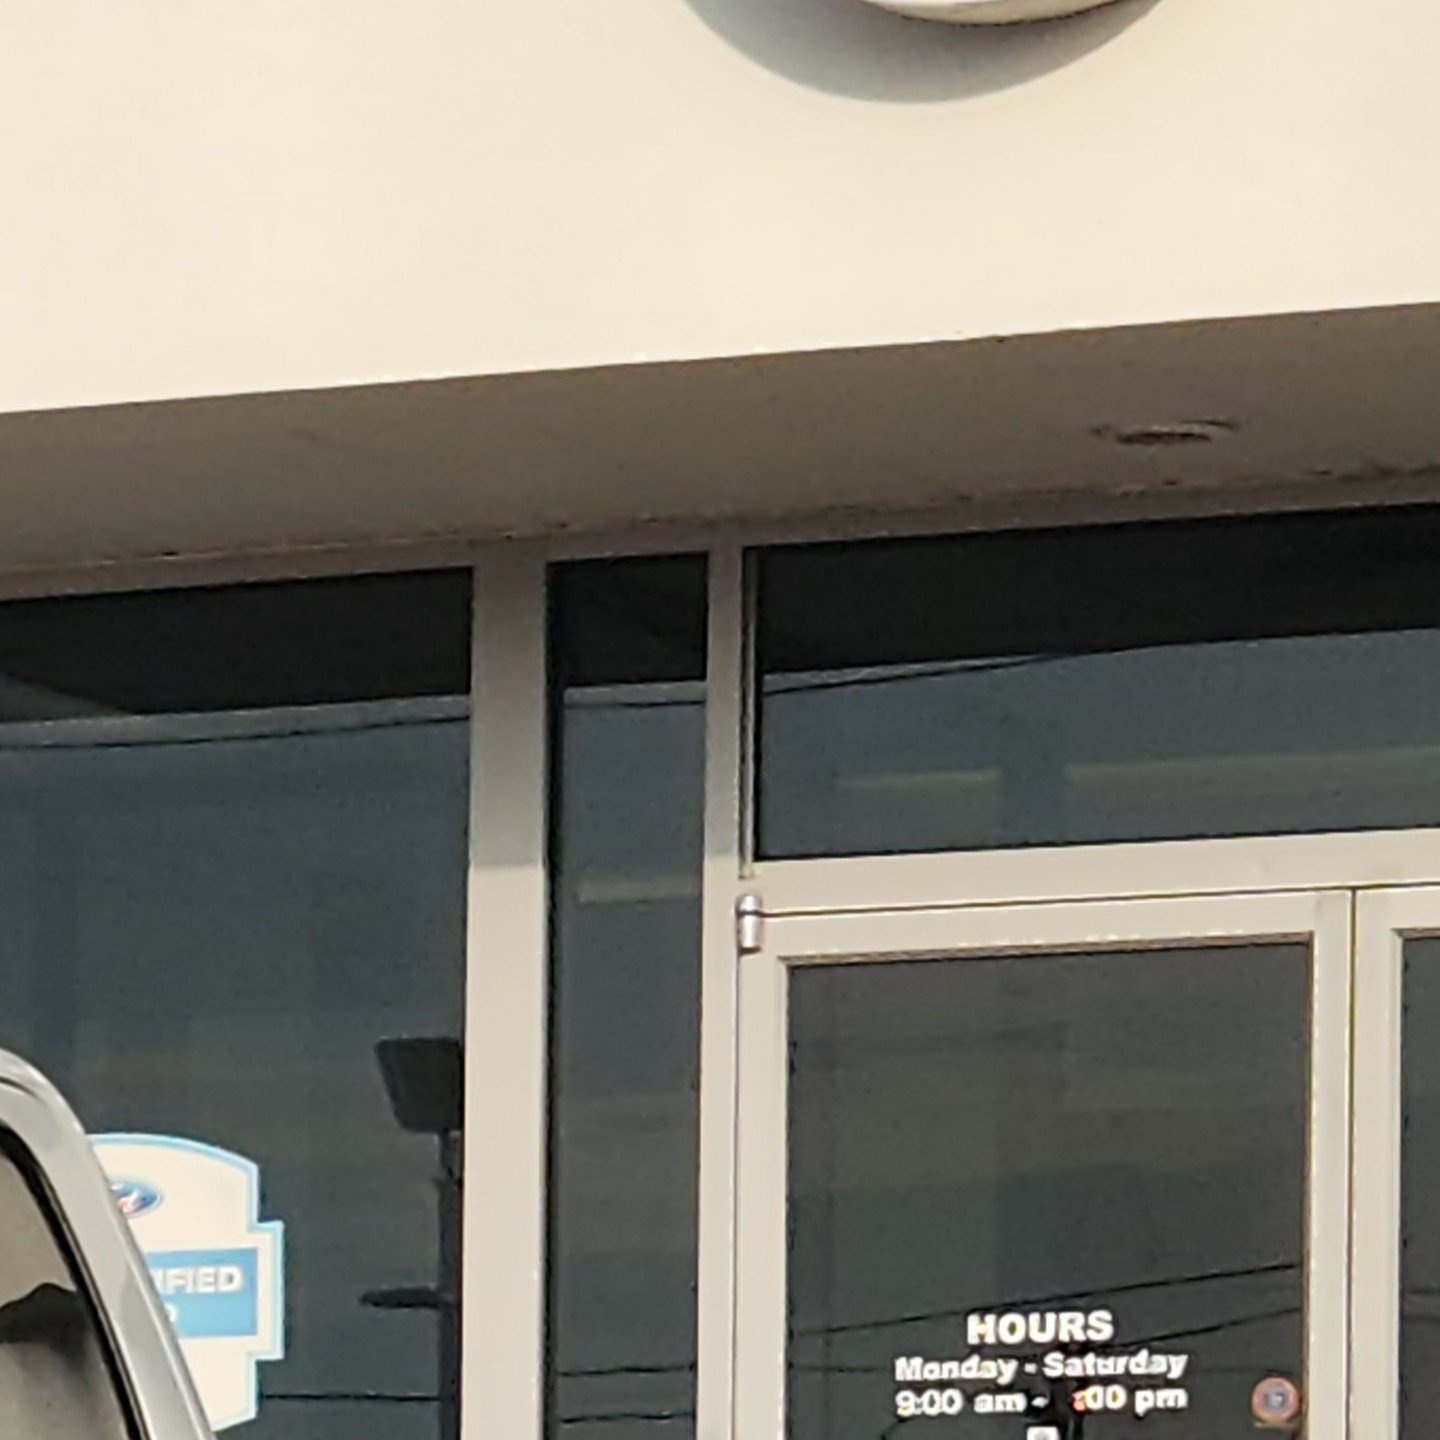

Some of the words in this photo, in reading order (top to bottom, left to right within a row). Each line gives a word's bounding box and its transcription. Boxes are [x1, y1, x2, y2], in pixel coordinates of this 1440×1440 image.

[151, 1266, 243, 1294] IFIED
[966, 1310, 1114, 1345] HOURS
[894, 1354, 1018, 1386] Monday
[1042, 1349, 1189, 1380] Saturday
[894, 1388, 964, 1417] 9:00
[973, 1392, 1027, 1413] am
[1072, 1384, 1127, 1412] :00
[1134, 1388, 1188, 1417] pm
